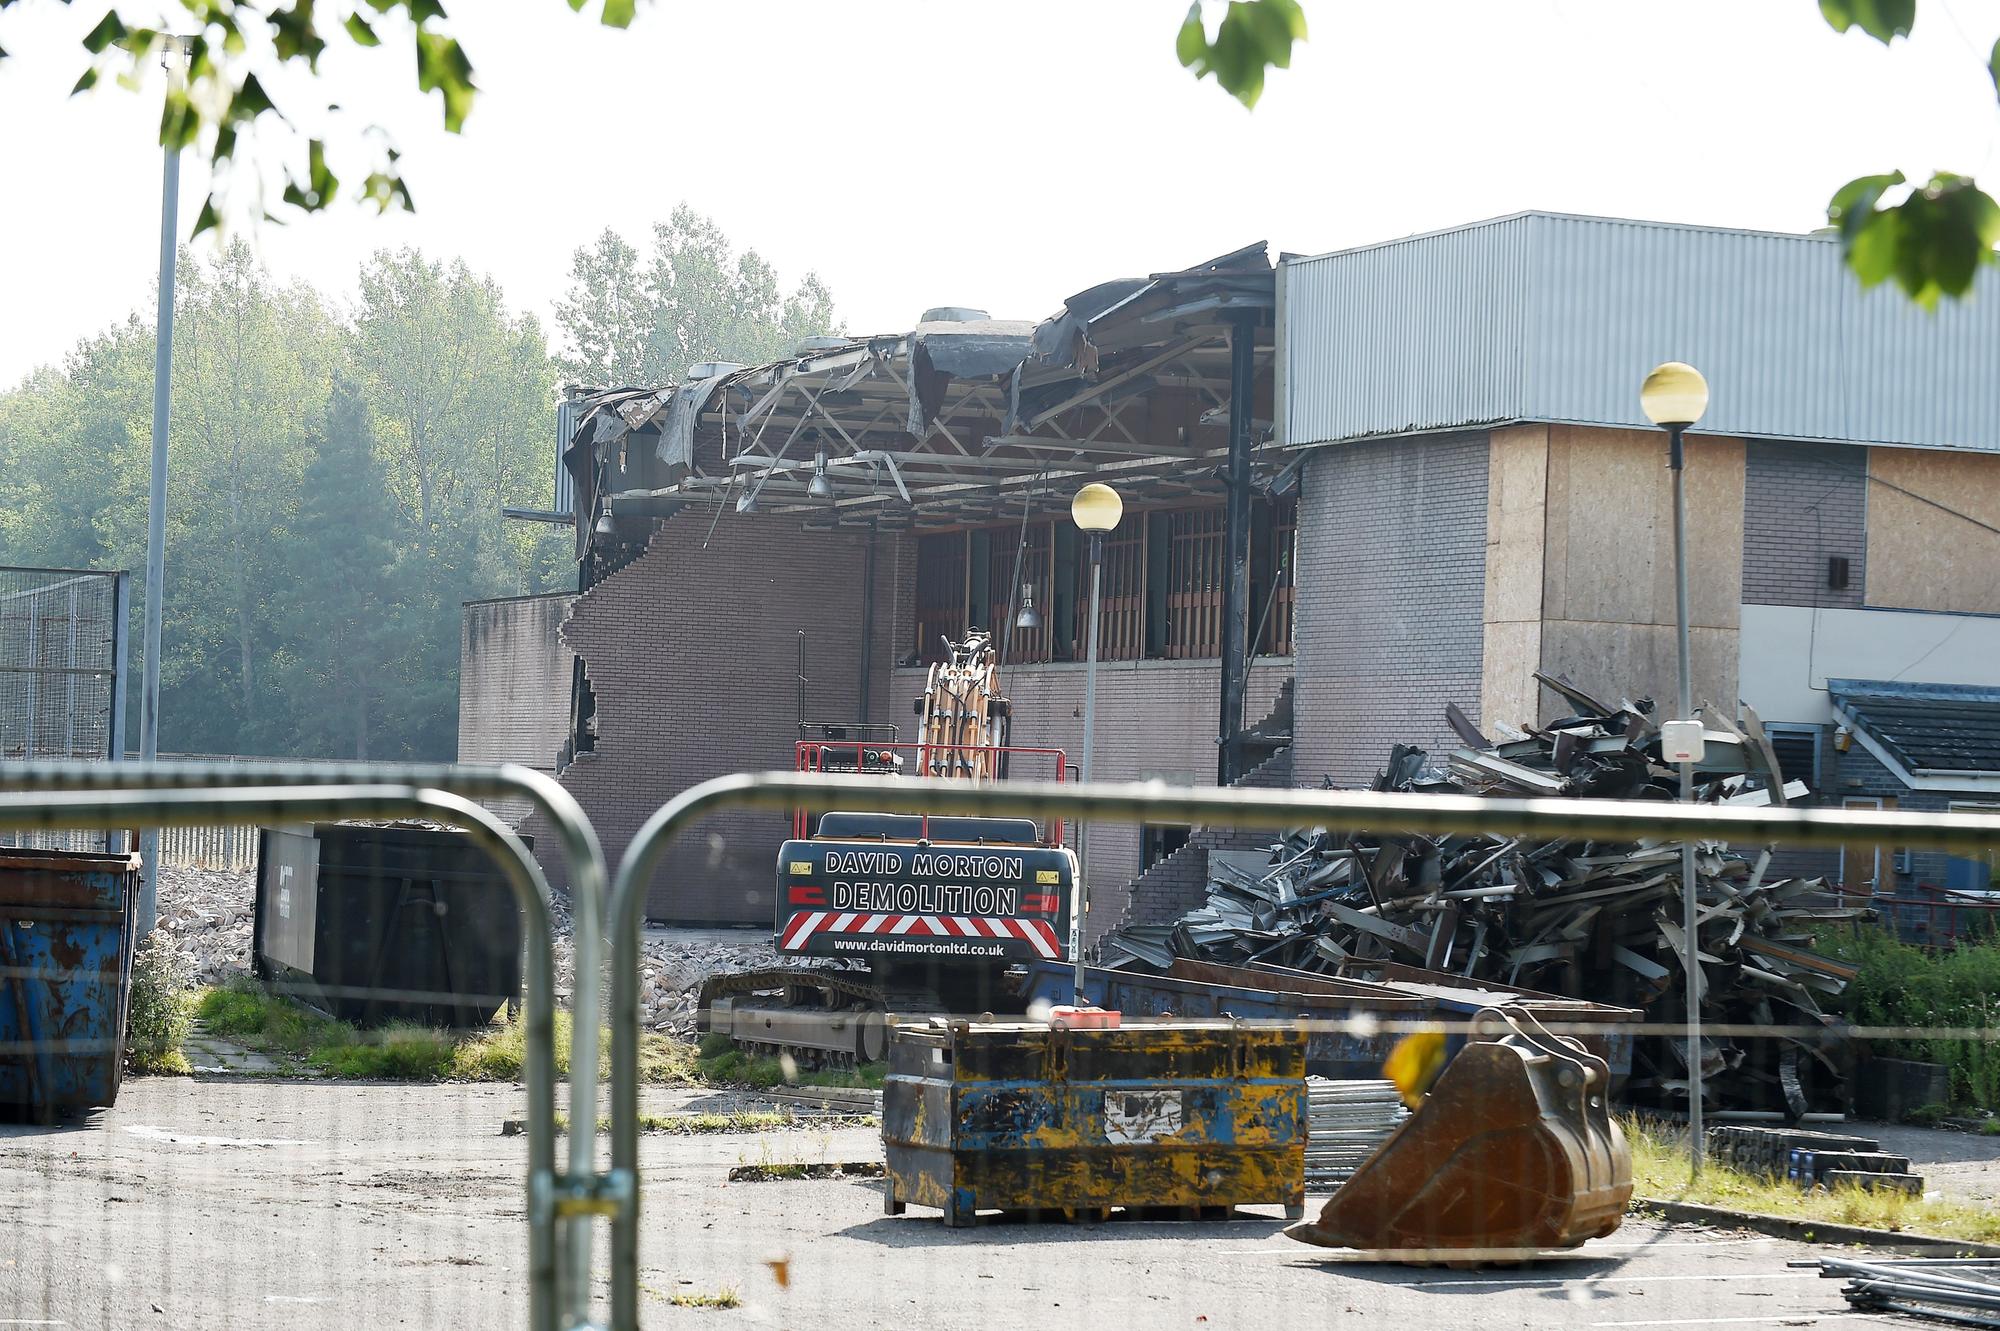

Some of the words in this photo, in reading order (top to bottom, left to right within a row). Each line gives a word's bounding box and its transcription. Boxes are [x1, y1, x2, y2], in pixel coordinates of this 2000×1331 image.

[825, 851, 902, 875] DAVID
[911, 854, 1023, 879] MORTON
[833, 881, 1017, 916] DEMOLITION
[834, 939, 1004, 956] www.davidmortonltd.co.uk
